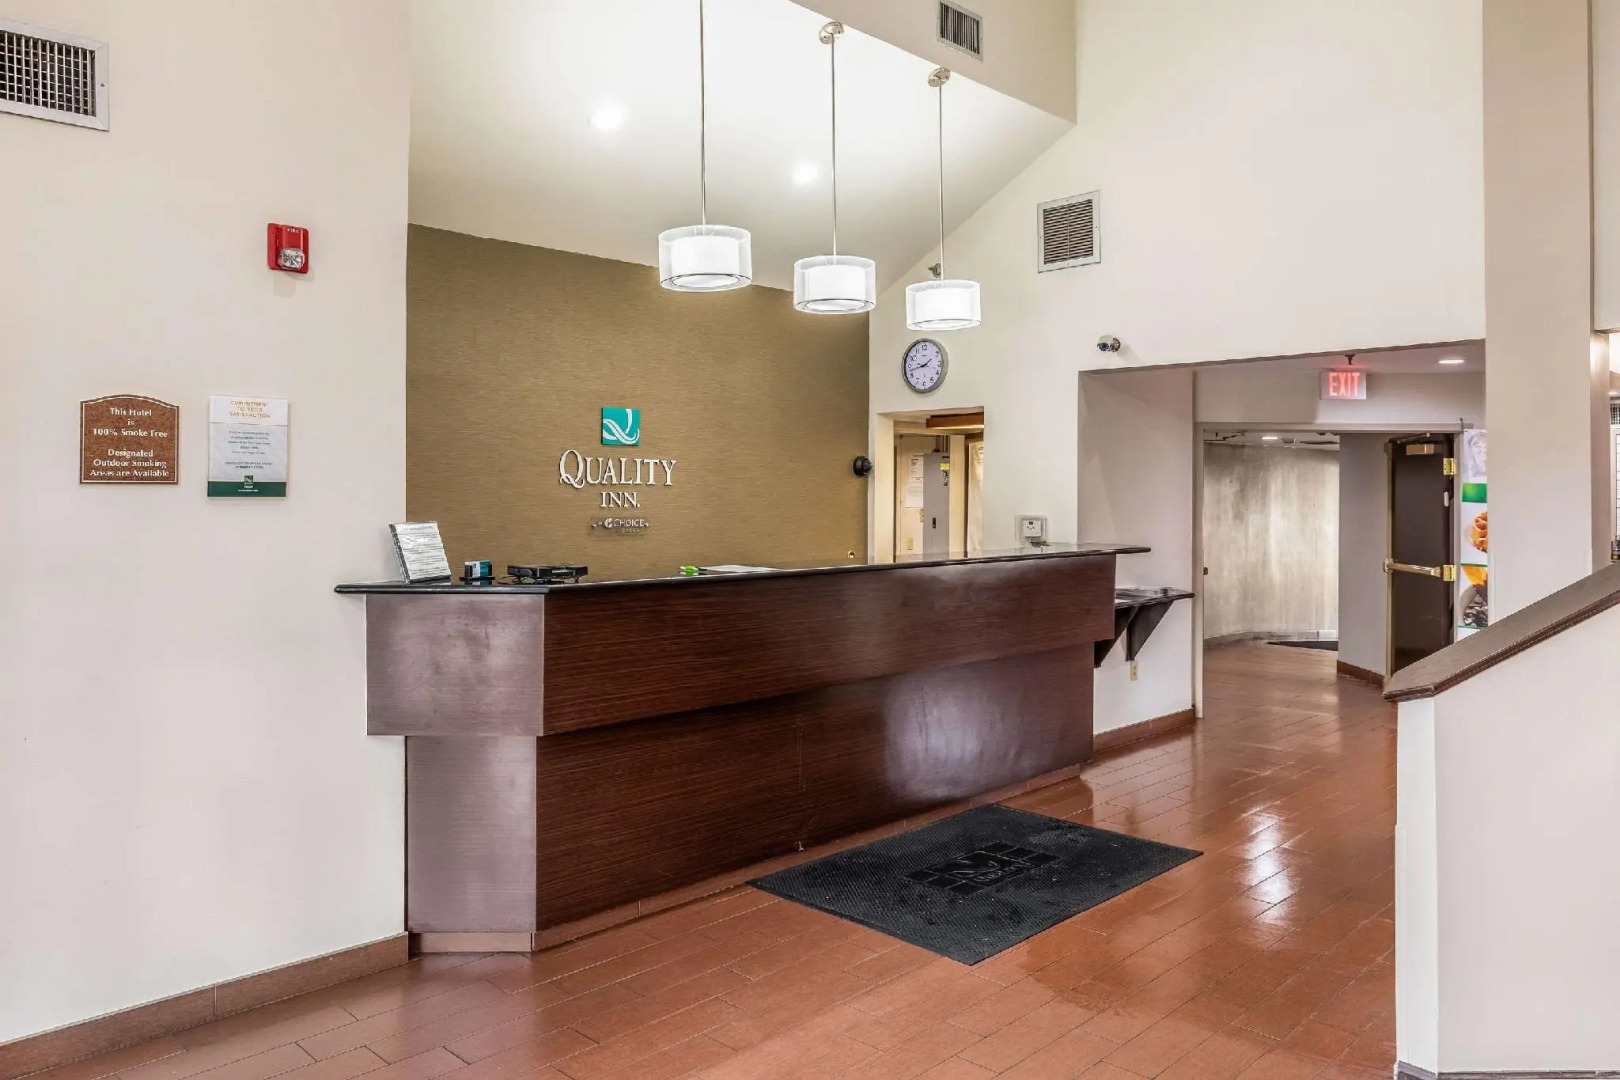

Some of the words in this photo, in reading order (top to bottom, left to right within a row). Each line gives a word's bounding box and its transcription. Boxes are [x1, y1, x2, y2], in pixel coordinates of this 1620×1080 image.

[1328, 372, 1360, 396] EXIT
[109, 407, 127, 416] This
[93, 428, 118, 436] 100%
[121, 428, 148, 437] Smoke
[150, 430, 169, 438] Free
[107, 448, 154, 459] Designated
[93, 459, 130, 467] Outdoor
[132, 460, 167, 469] Smoking
[559, 449, 677, 489] QUALITY
[89, 469, 113, 477] Areas
[132, 469, 169, 478] Available
[613, 518, 645, 527] CHOICE
